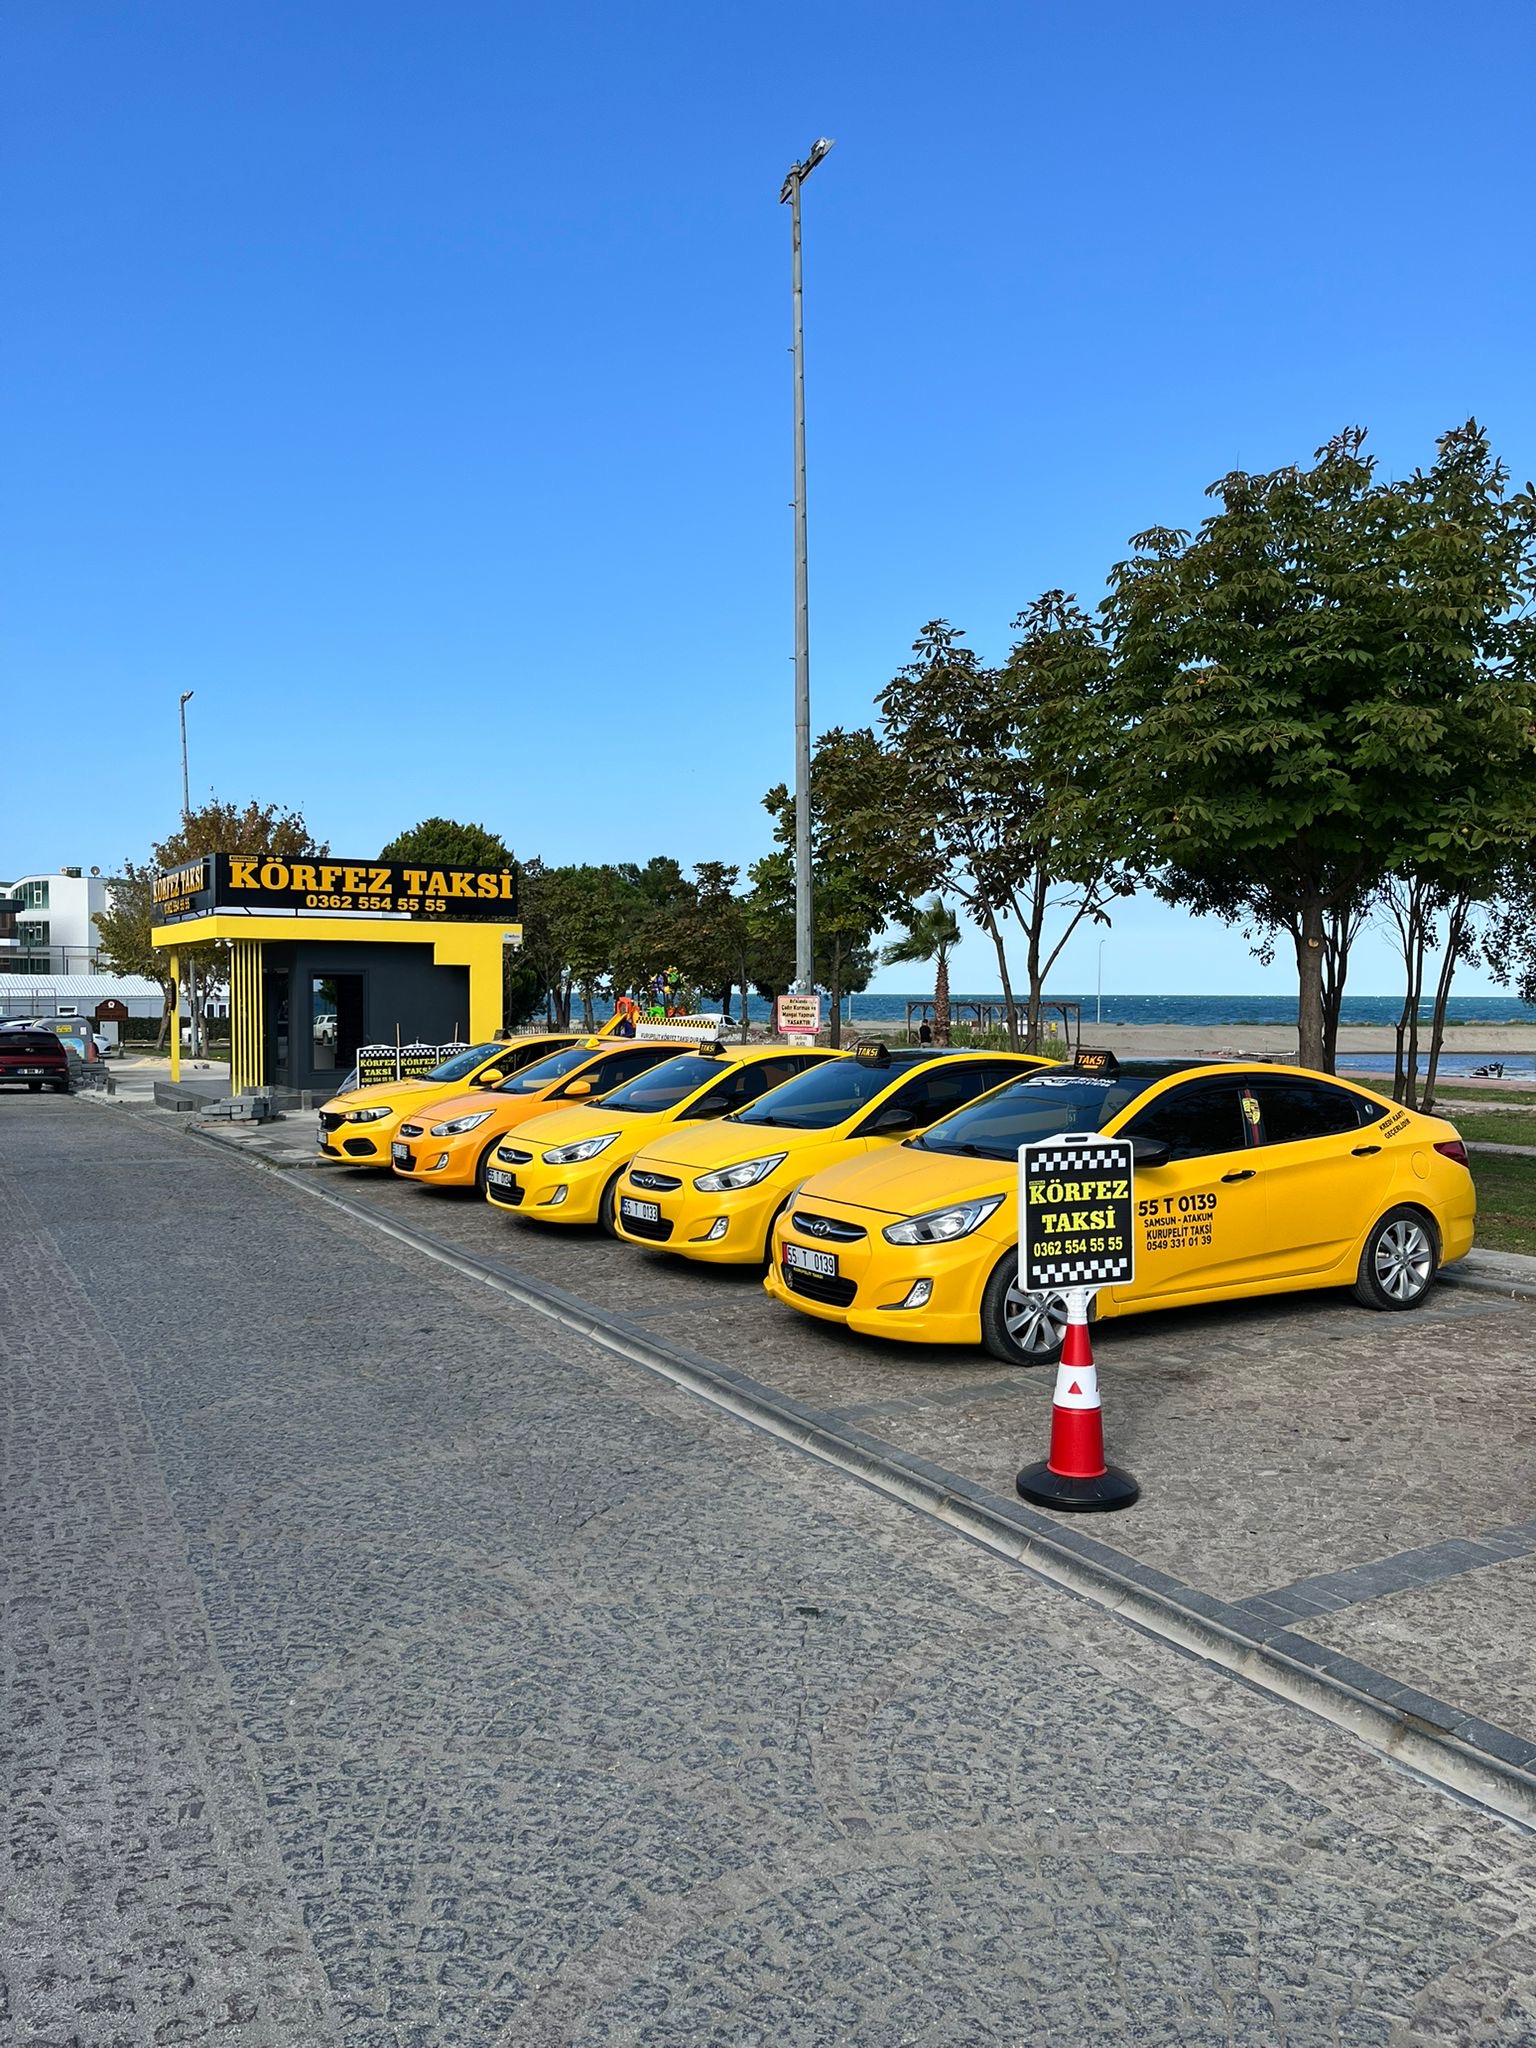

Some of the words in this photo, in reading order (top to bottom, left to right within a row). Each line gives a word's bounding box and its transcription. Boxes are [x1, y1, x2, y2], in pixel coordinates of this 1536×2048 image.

[229, 857, 392, 895] KÖRFEZ
[403, 868, 513, 899] TAKSİ
[306, 895, 352, 909] 0362
[358, 896, 392, 910] 554
[398, 898, 420, 912] 55
[425, 899, 447, 912] 55
[360, 1059, 397, 1067] KÖRFEZ
[364, 1067, 392, 1076] TAKSİ
[401, 1058, 436, 1066] KÖRFEZ
[1379, 1117, 1393, 1130] KREDİ
[1392, 1110, 1405, 1122] KARTI
[1029, 1178, 1129, 1205] KÖRFEZ
[624, 1200, 631, 1214] 55
[643, 1204, 657, 1220] 0133
[1138, 1199, 1159, 1217] 55
[1163, 1197, 1174, 1214] T
[1178, 1193, 1217, 1212] 0139
[1041, 1205, 1116, 1234] TAKSİ
[1144, 1216, 1176, 1228] SAMSUN
[1183, 1212, 1214, 1223] ATAKUM
[1146, 1225, 1188, 1240] KURUPELİT
[1190, 1222, 1212, 1236] TAKSİ
[1033, 1241, 1062, 1257] 0362
[1065, 1239, 1087, 1254] 554
[1090, 1237, 1105, 1252] 55
[1108, 1236, 1123, 1251] 55
[1146, 1240, 1168, 1251] 0549
[1170, 1238, 1186, 1249] 331
[1188, 1236, 1198, 1247] 01
[1201, 1235, 1212, 1245] 39
[787, 1246, 797, 1264] 55
[802, 1250, 807, 1267] T
[814, 1253, 834, 1274] 0139
